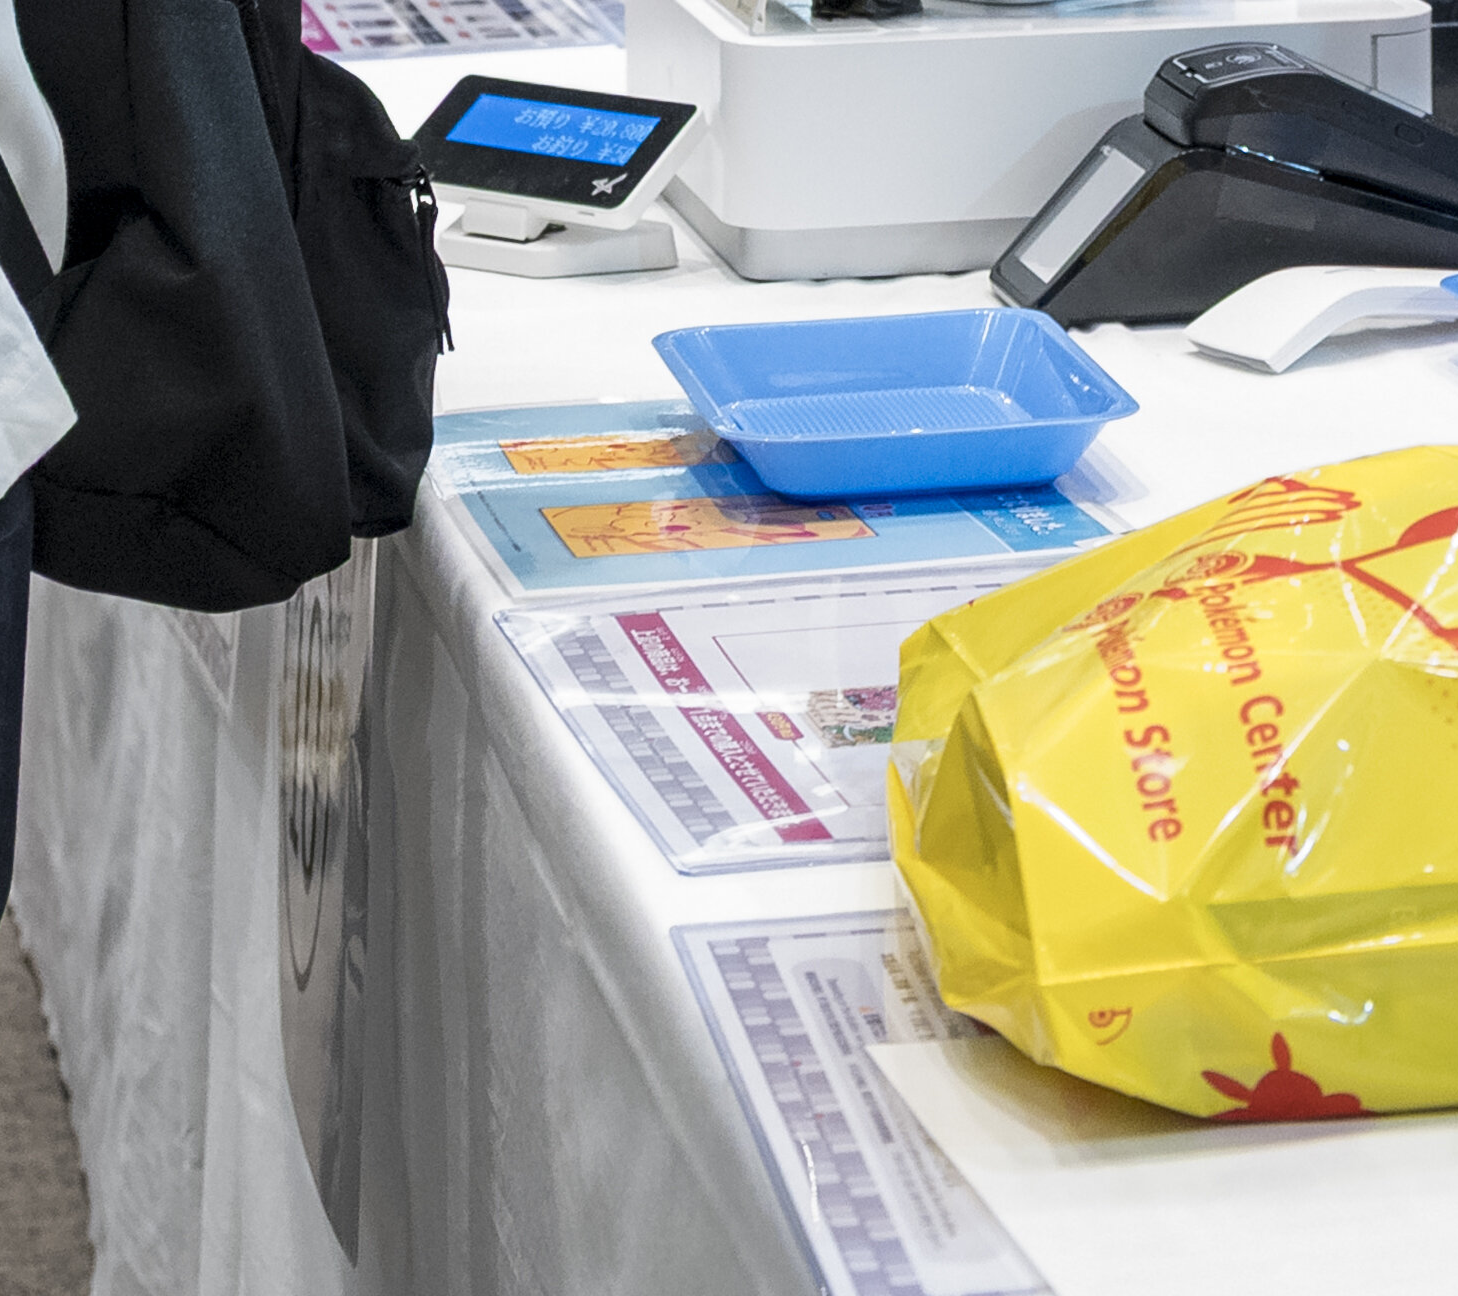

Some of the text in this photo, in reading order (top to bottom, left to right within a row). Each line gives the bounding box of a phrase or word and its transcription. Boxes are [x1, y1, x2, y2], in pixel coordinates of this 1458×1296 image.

[1122, 724, 1184, 843] Store
[1198, 584, 1300, 858] Pokémon Center
